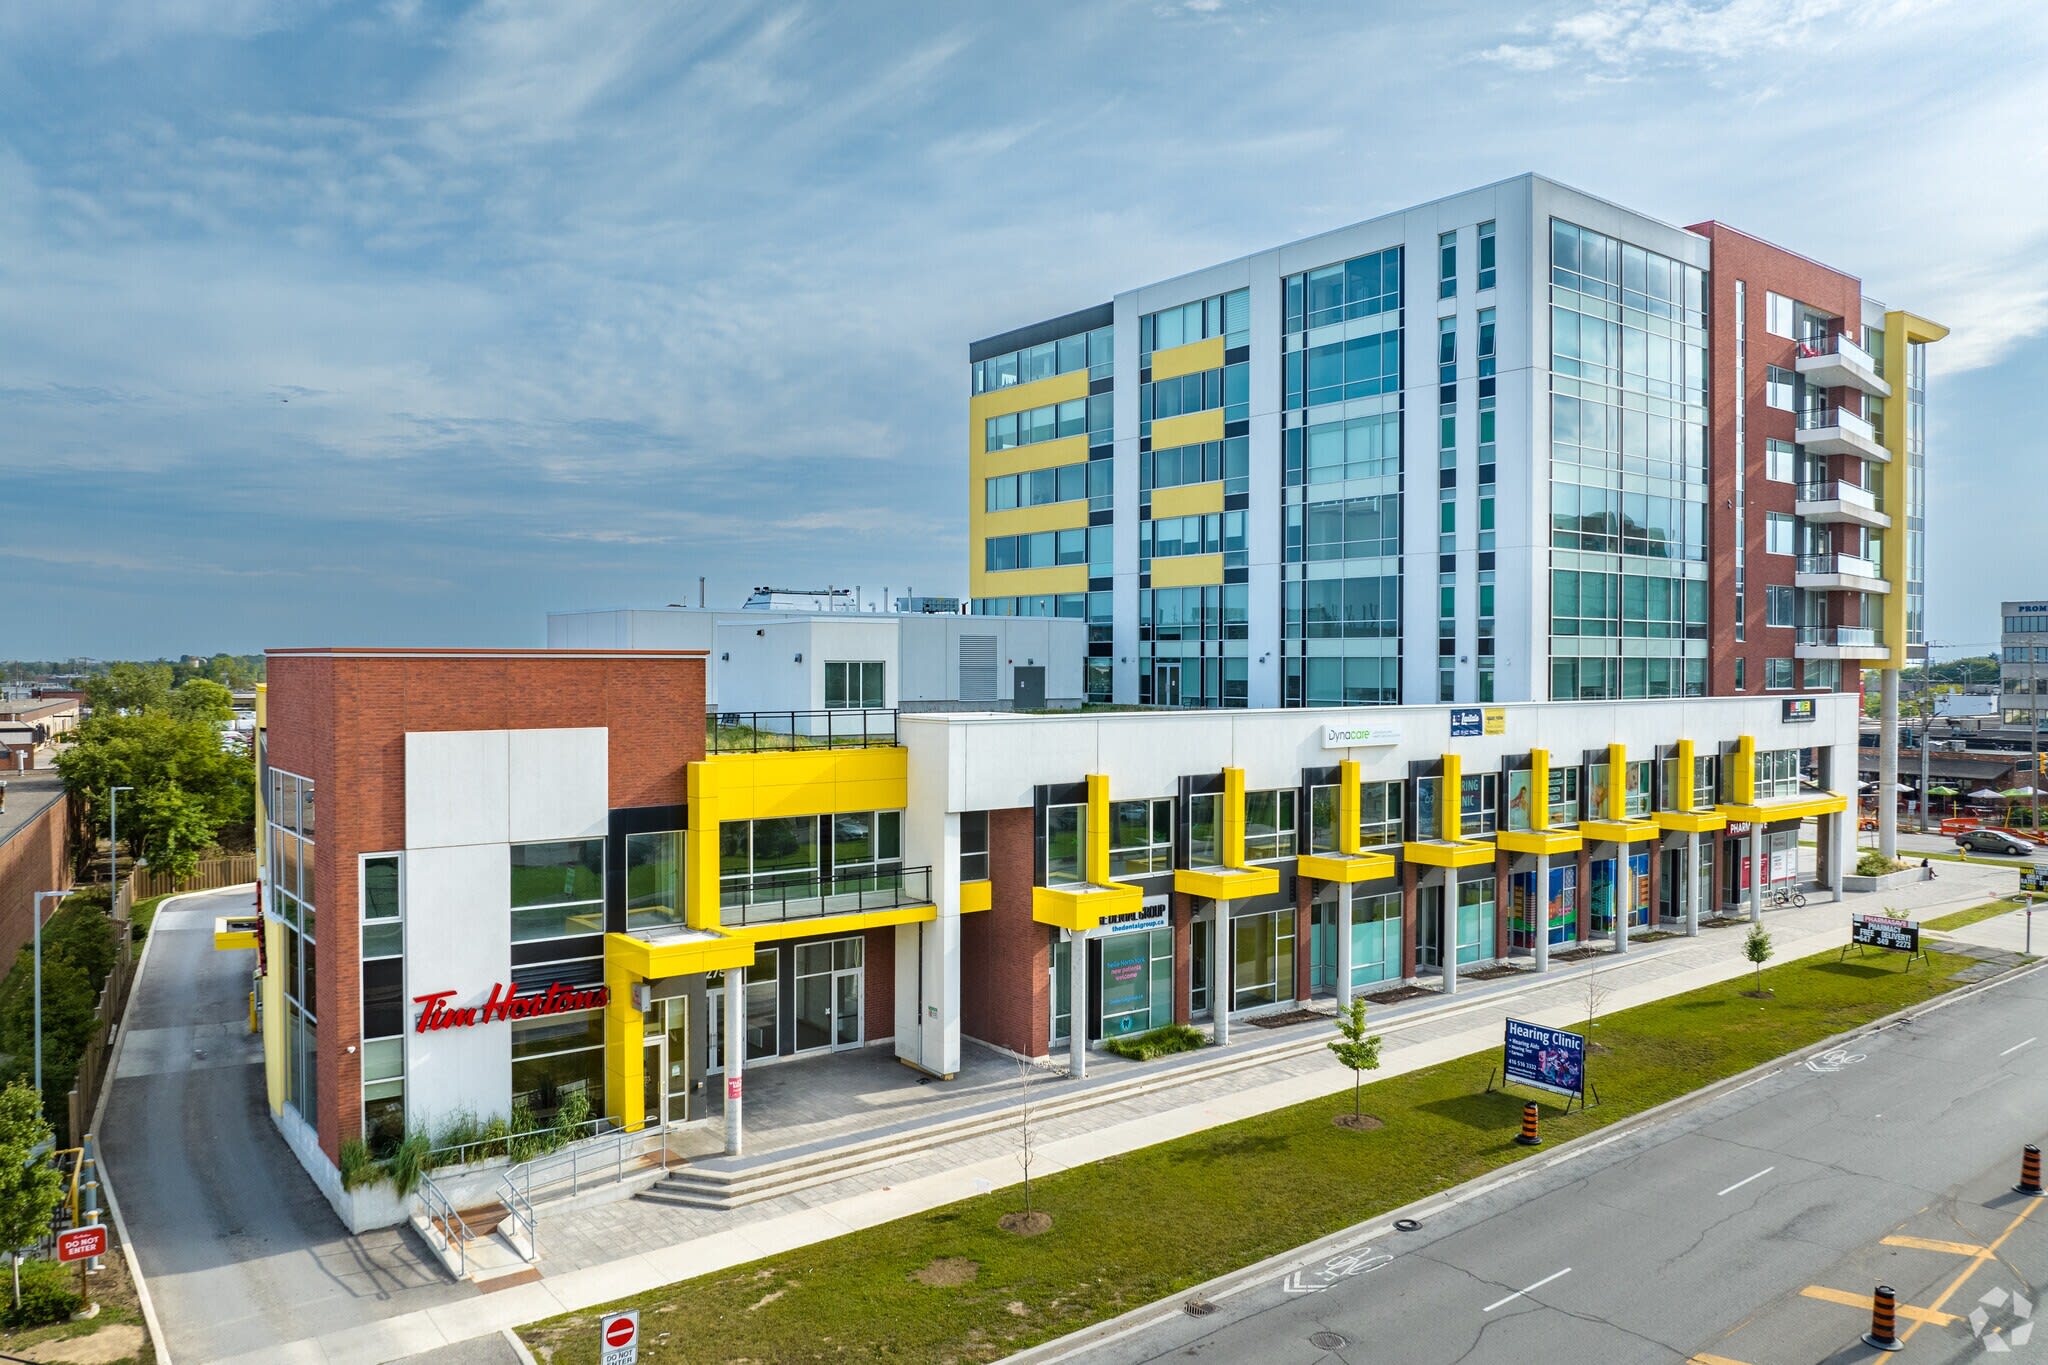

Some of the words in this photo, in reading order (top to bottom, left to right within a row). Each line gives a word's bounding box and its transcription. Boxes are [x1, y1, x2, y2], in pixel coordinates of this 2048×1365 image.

[2018, 605, 2047, 613] PROM
[1328, 728, 1370, 743] Dynacare
[1462, 779, 1479, 792] RING
[1462, 795, 1475, 807] NIC
[1138, 904, 1166, 920] GROUP
[1112, 920, 1164, 932] thedentalgroup.ca
[1860, 927, 1875, 937] FREE
[1868, 922, 1901, 933] PHARMACY
[413, 990, 476, 1034] Tim
[482, 982, 609, 1025] Hortons
[1509, 1022, 1549, 1045] Hearing
[1552, 1033, 1581, 1050] Clinic
[65, 1240, 80, 1249] DO
[80, 1236, 100, 1246] NOT
[68, 1244, 97, 1255] ENTER
[606, 1354, 617, 1362] DO
[618, 1350, 633, 1359] NOT
